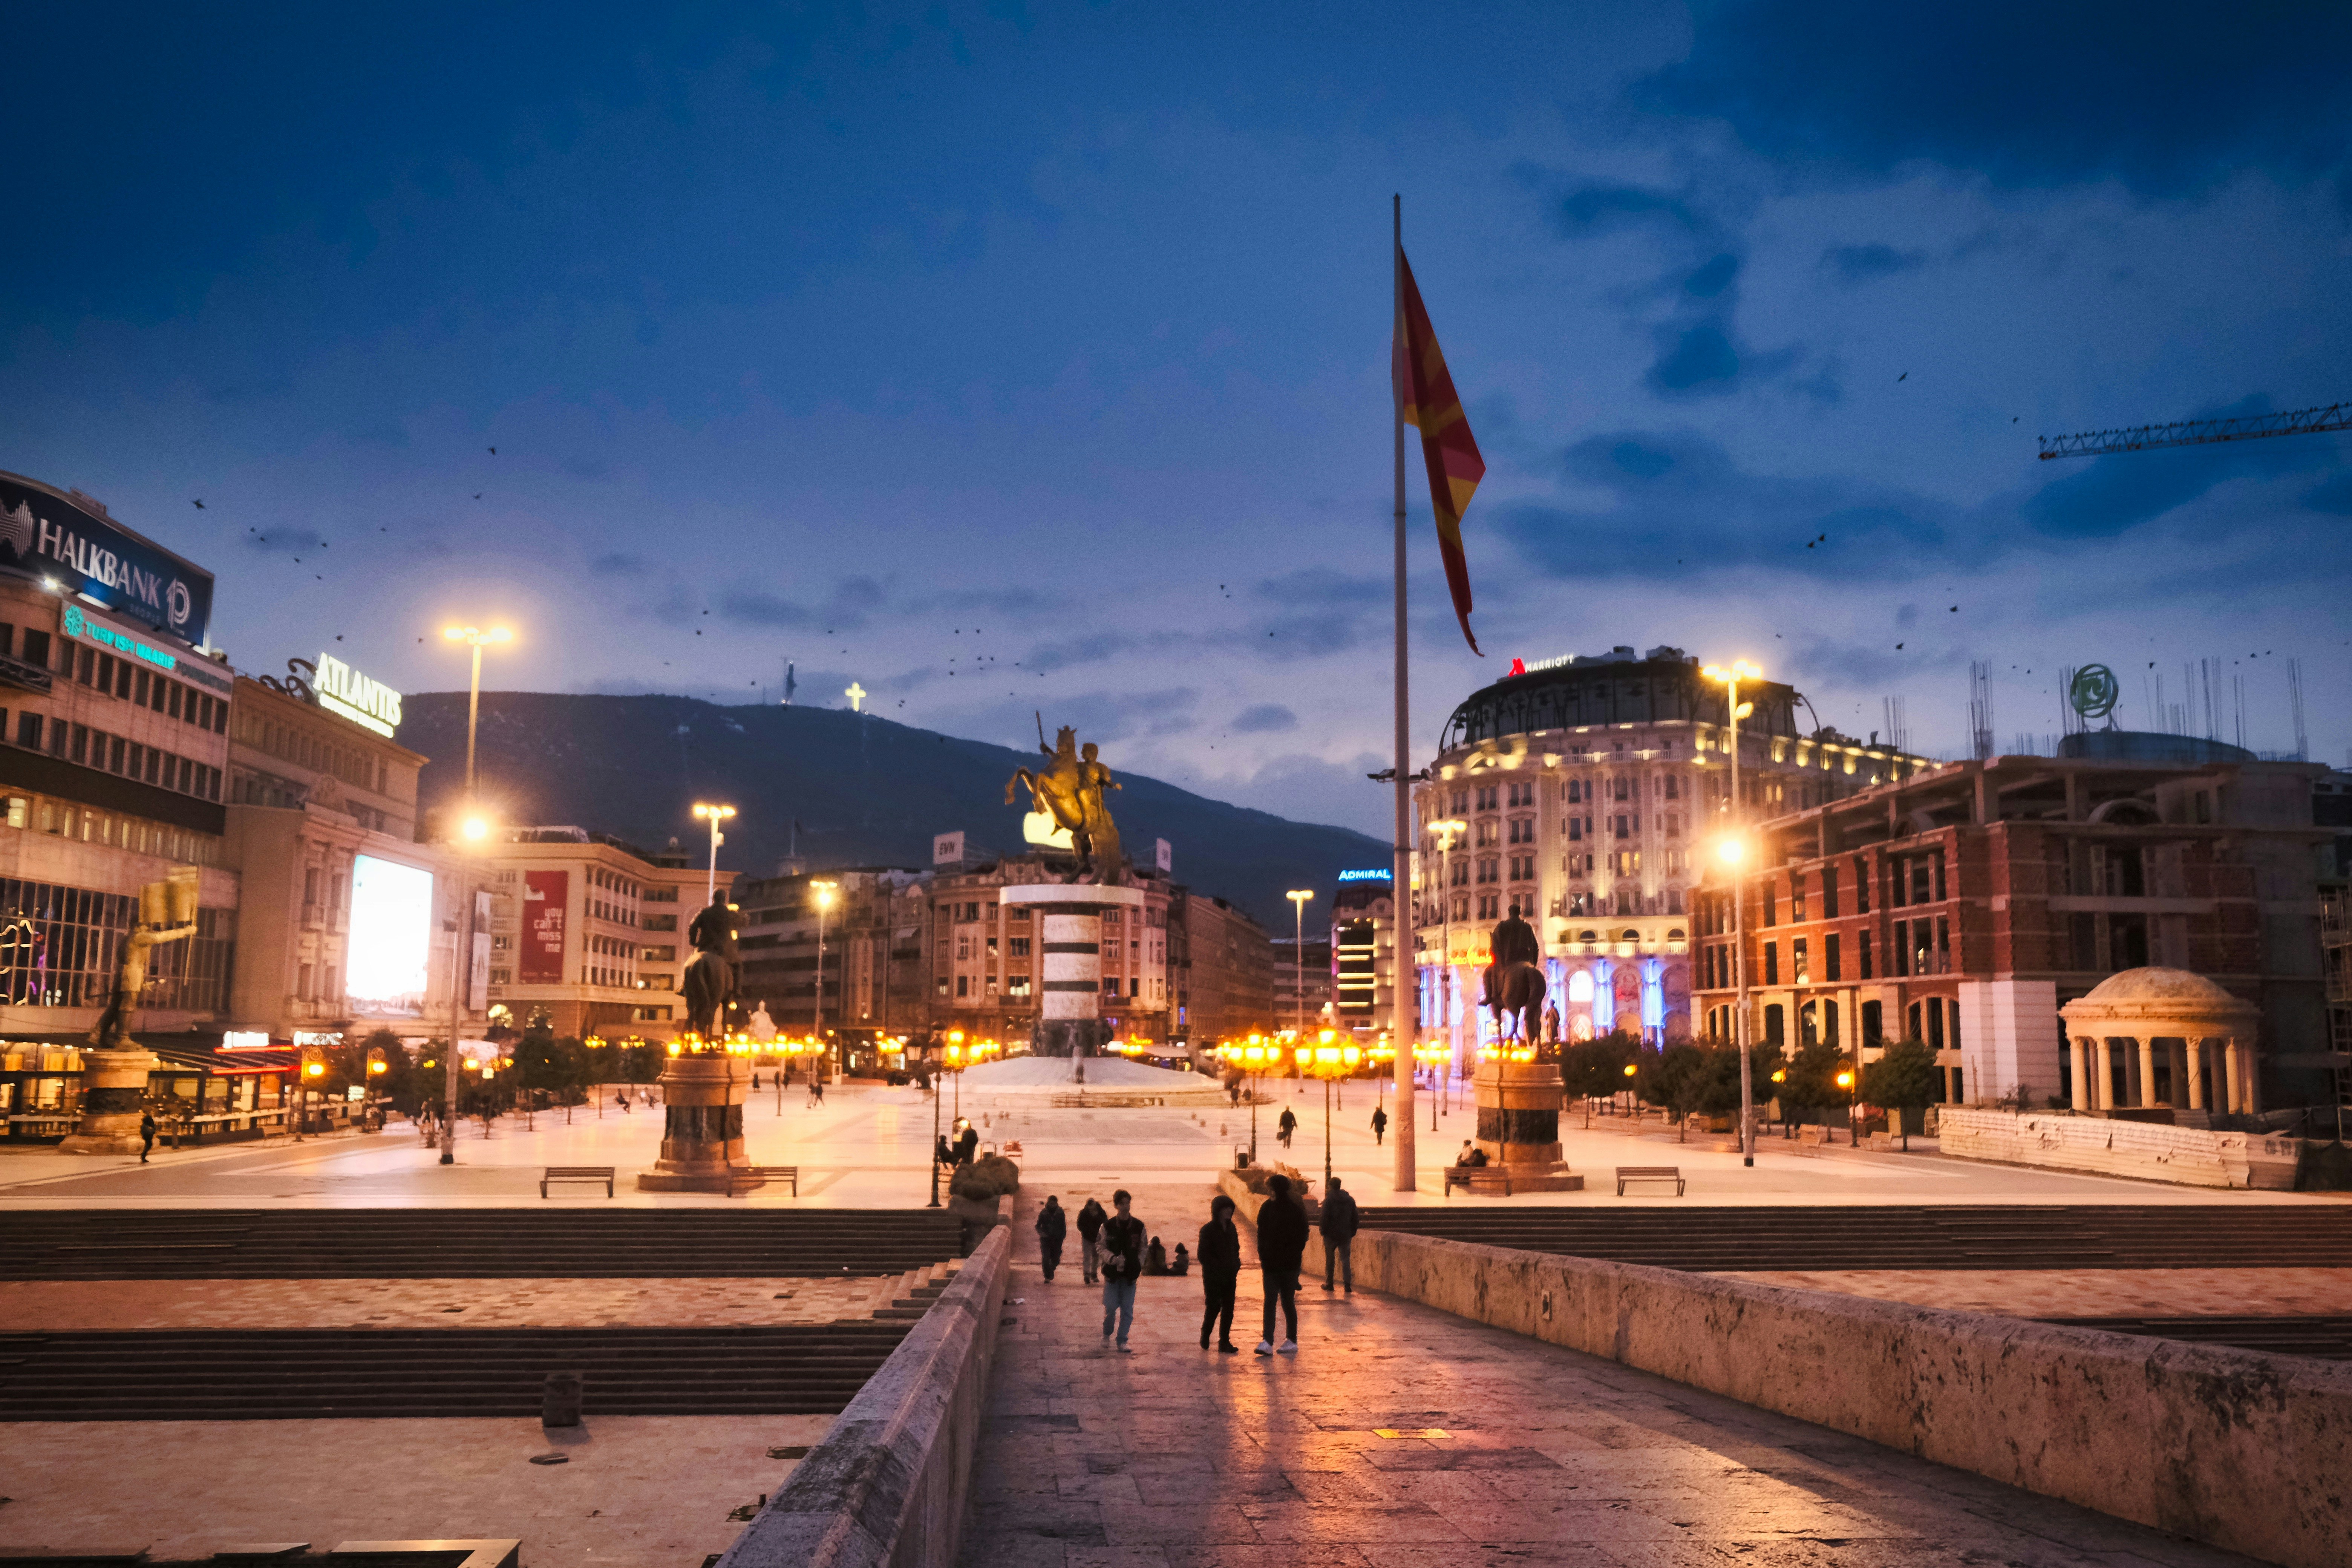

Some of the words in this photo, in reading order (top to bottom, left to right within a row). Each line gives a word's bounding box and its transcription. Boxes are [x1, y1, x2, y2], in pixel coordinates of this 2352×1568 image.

[37, 518, 162, 609] HALKBANK
[136, 642, 176, 670] MAARIF
[1525, 654, 1574, 673] MARRIOTT
[313, 652, 402, 726] ATLANTIS
[939, 841, 955, 855] EVN
[1338, 869, 1392, 881] ADMIRAL
[544, 908, 564, 919] you
[537, 931, 562, 941] miss
[545, 943, 561, 953] me
